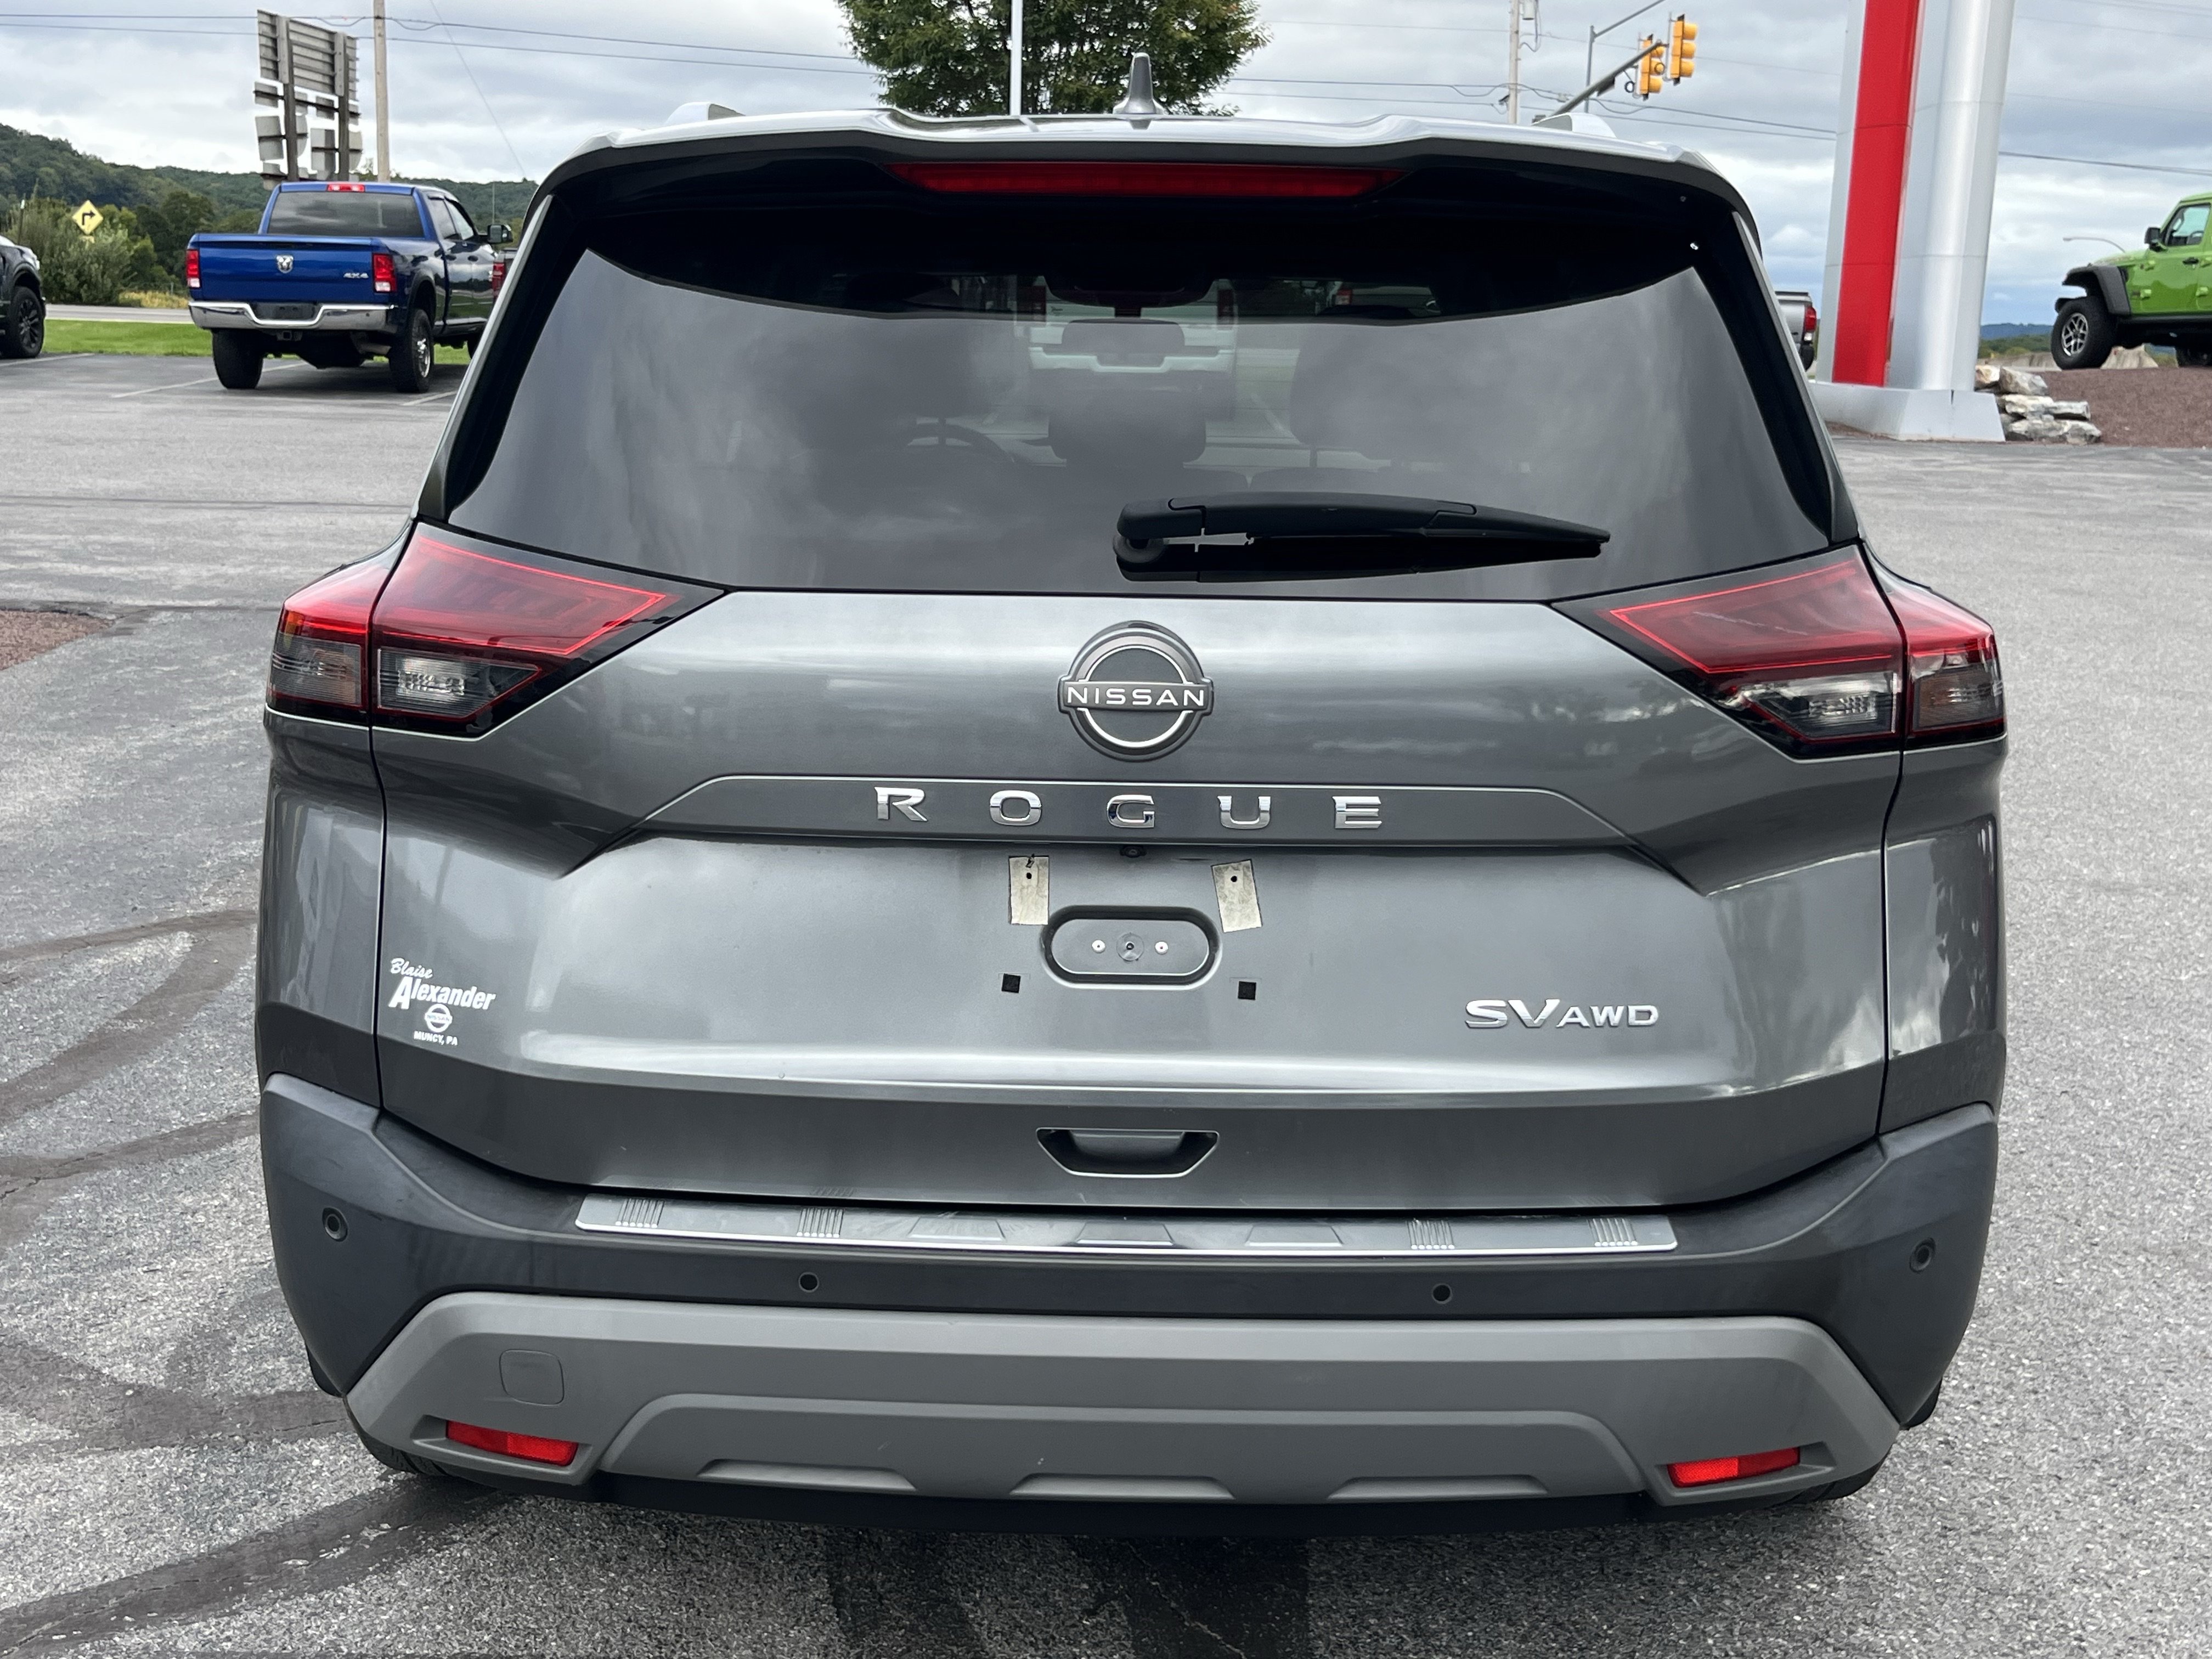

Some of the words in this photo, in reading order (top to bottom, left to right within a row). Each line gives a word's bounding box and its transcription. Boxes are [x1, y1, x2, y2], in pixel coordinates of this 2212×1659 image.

[1067, 687, 1204, 707] NISSAN
[874, 786, 1383, 830] ROGUE
[390, 957, 433, 979] Blaise
[388, 975, 496, 1010] Alexander
[446, 1035, 458, 1046] PA
